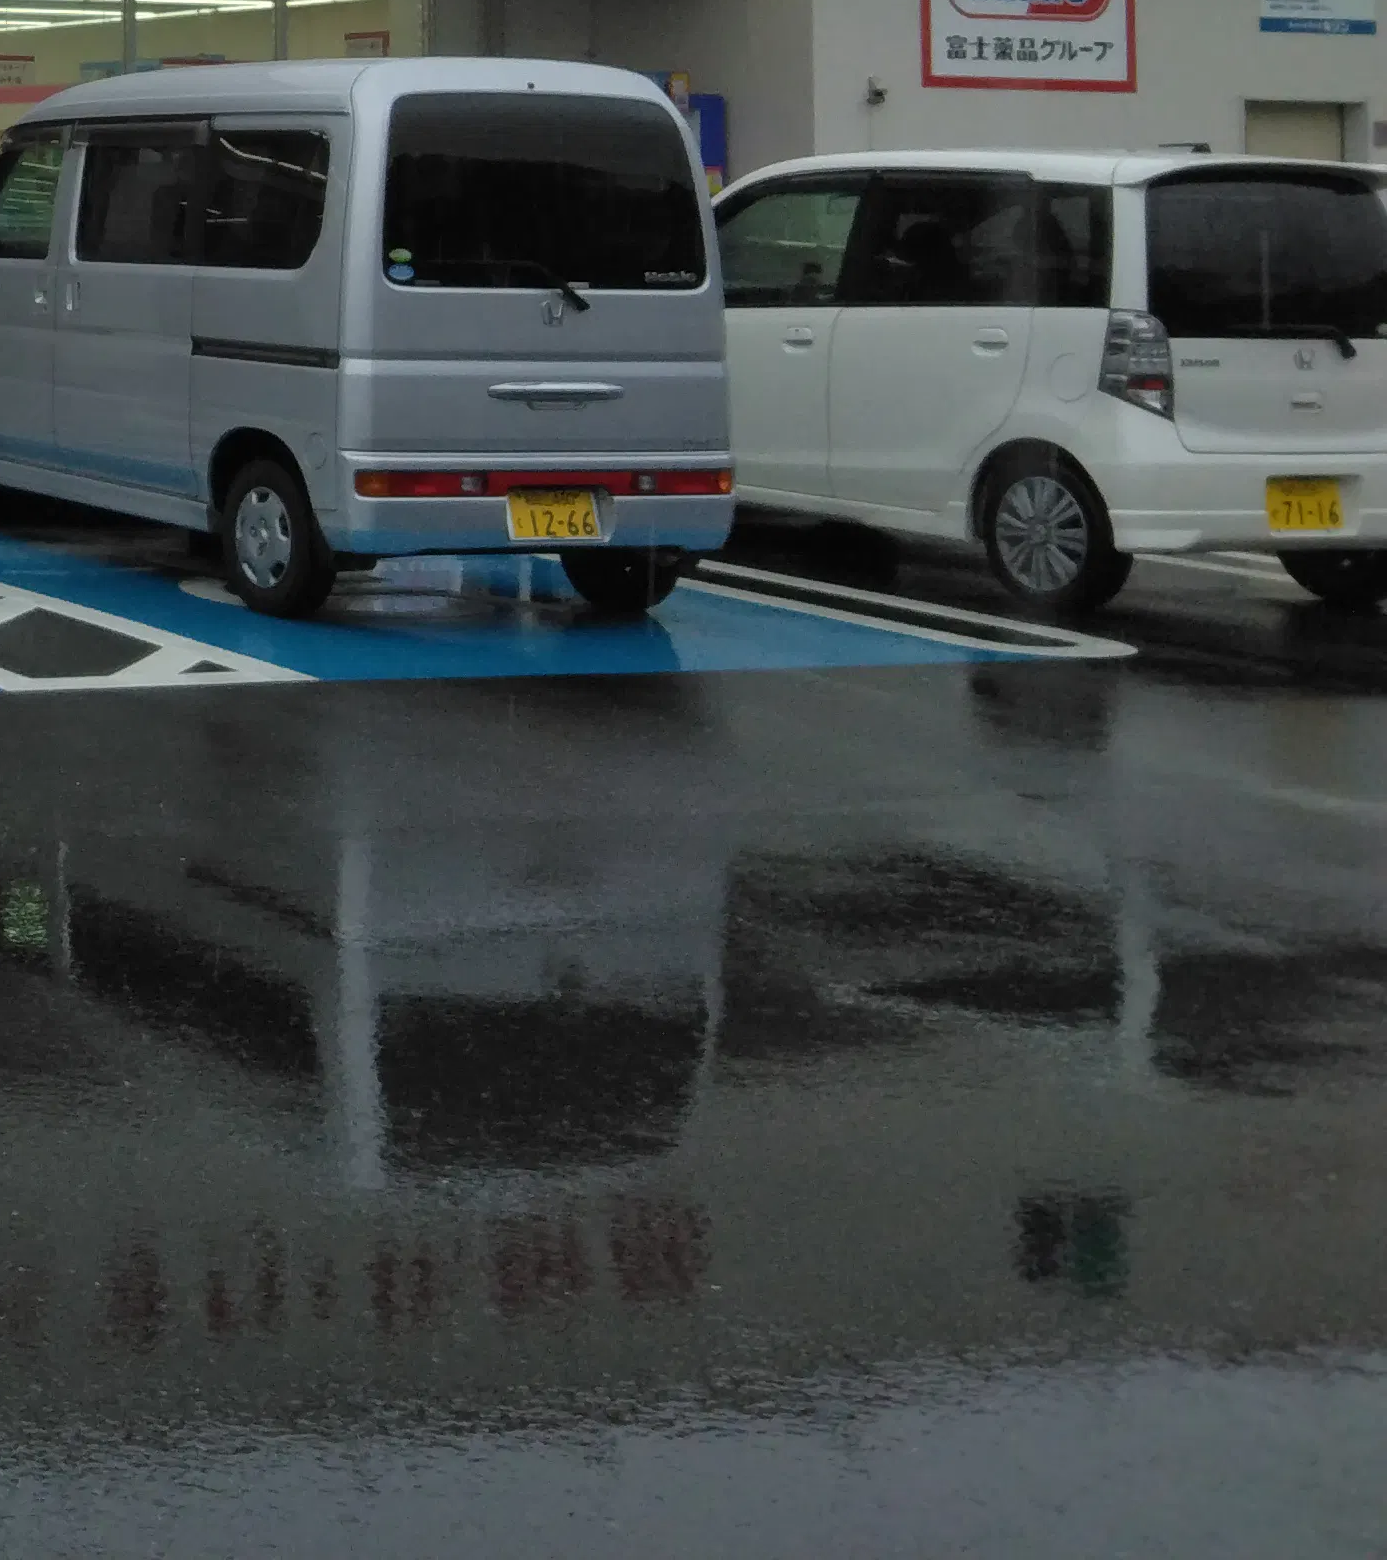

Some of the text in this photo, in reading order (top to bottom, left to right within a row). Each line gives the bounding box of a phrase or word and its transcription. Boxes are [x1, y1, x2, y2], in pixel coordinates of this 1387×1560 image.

[945, 35, 1114, 62] 富士薬品グループ
[529, 509, 595, 536] 12-66
[1282, 500, 1340, 526] 71-16
